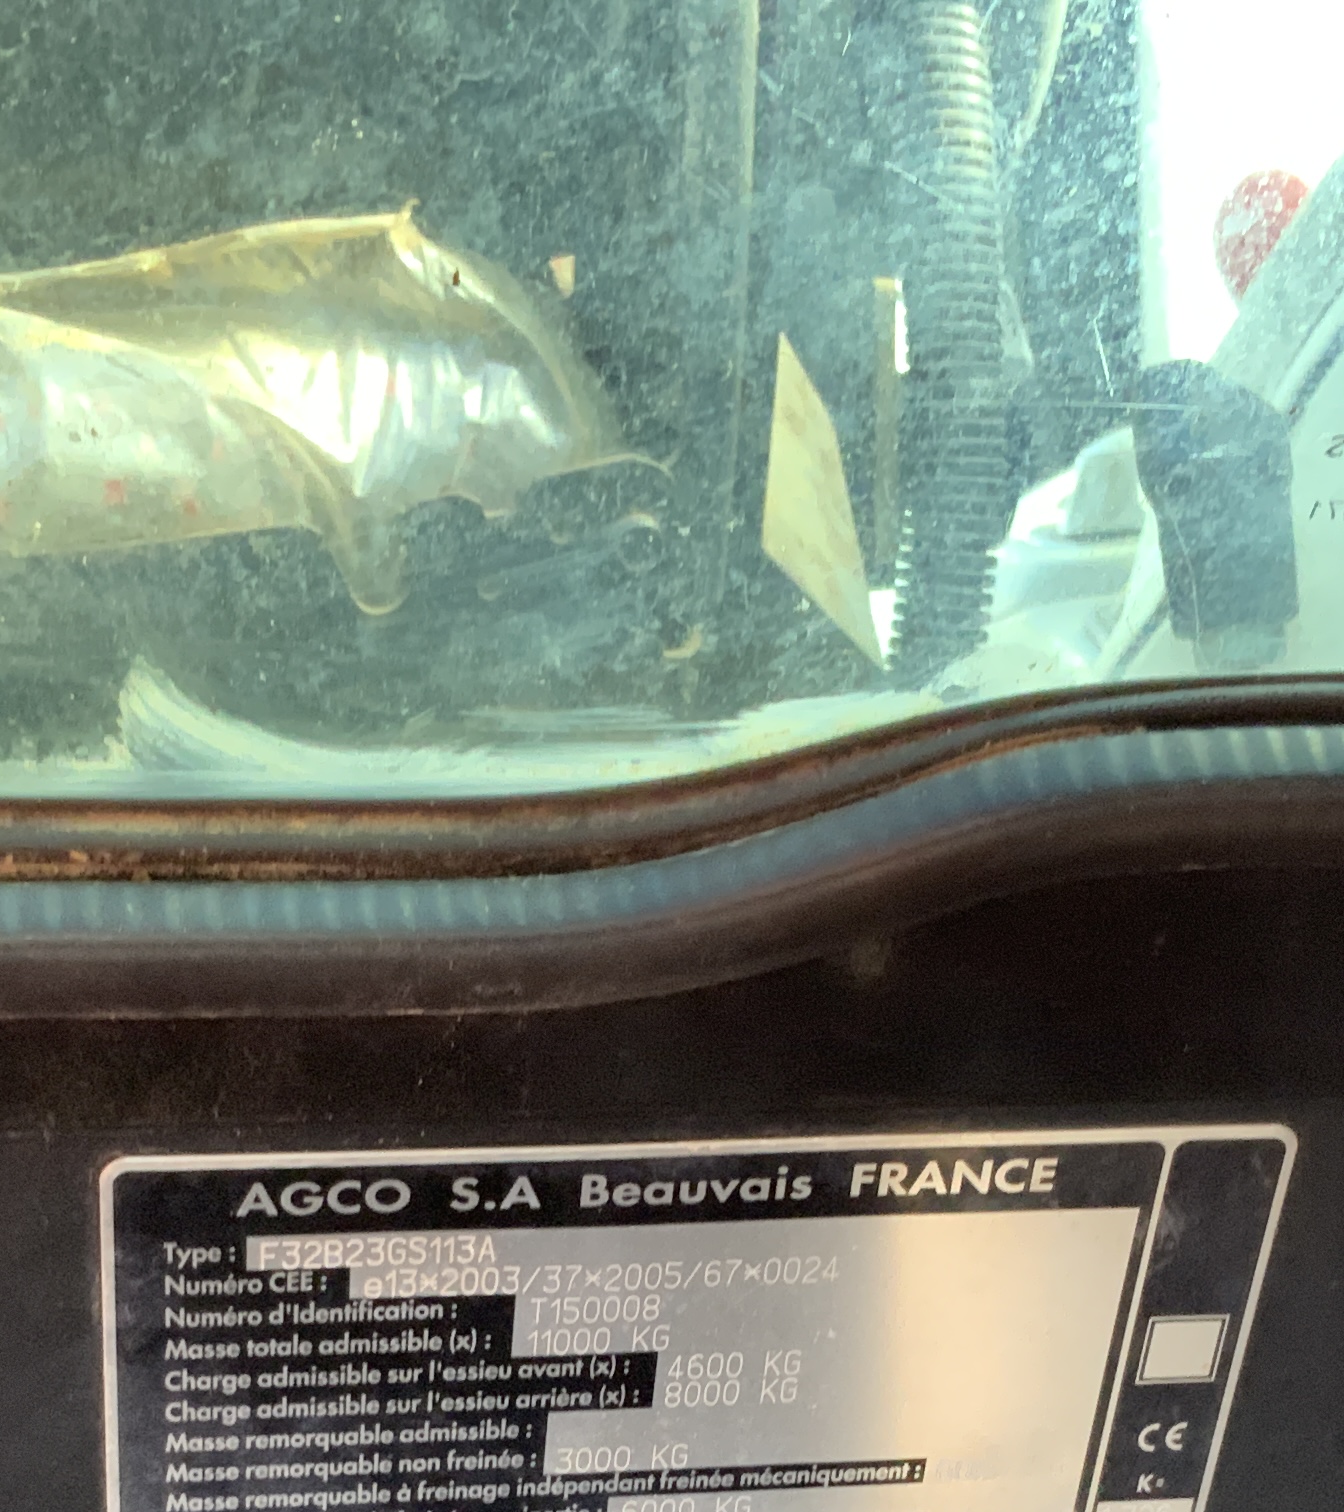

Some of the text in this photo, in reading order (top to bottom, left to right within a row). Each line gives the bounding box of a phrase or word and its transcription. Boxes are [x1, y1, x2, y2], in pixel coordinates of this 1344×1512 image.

[236, 1157, 1059, 1218] AGCO S.A Beauvais FRANCE
[164, 1242, 223, 1268] Type
[256, 1237, 496, 1271] F32B23GS113A
[164, 1271, 263, 1297] Numéro
[269, 1271, 314, 1292] CEE
[164, 1302, 264, 1328] Numéro
[531, 1295, 661, 1325] T150008
[164, 1340, 240, 1362] Masse
[247, 1337, 318, 1358] totale
[321, 1332, 444, 1355] admissible
[527, 1327, 612, 1356] 11000
[631, 1325, 671, 1350] KG
[165, 1369, 251, 1395] Charge
[258, 1362, 381, 1389] admissible
[388, 1367, 423, 1384] sur
[518, 1357, 584, 1380] avant
[668, 1351, 743, 1380] 4600
[764, 1350, 801, 1376] KG
[165, 1399, 251, 1427] Charge
[257, 1392, 380, 1420] admissible
[386, 1398, 421, 1414] sur
[516, 1386, 592, 1410] arrière
[664, 1381, 740, 1408] 8000
[759, 1378, 797, 1404] KG
[166, 1432, 239, 1454] Masse
[245, 1424, 392, 1451] remorquable
[399, 1418, 518, 1445] admissible
[166, 1462, 238, 1484] Masse
[245, 1454, 392, 1482] remorquable
[399, 1458, 440, 1473] non
[447, 1448, 524, 1472] freinée
[556, 1446, 631, 1474] 3000
[651, 1444, 688, 1468] KG
[245, 1485, 391, 1511] remorquable
[418, 1479, 510, 1505] freinage
[517, 1472, 654, 1502] indépendant
[660, 1469, 733, 1492] freinée
[740, 1461, 909, 1486] mécaniquement
